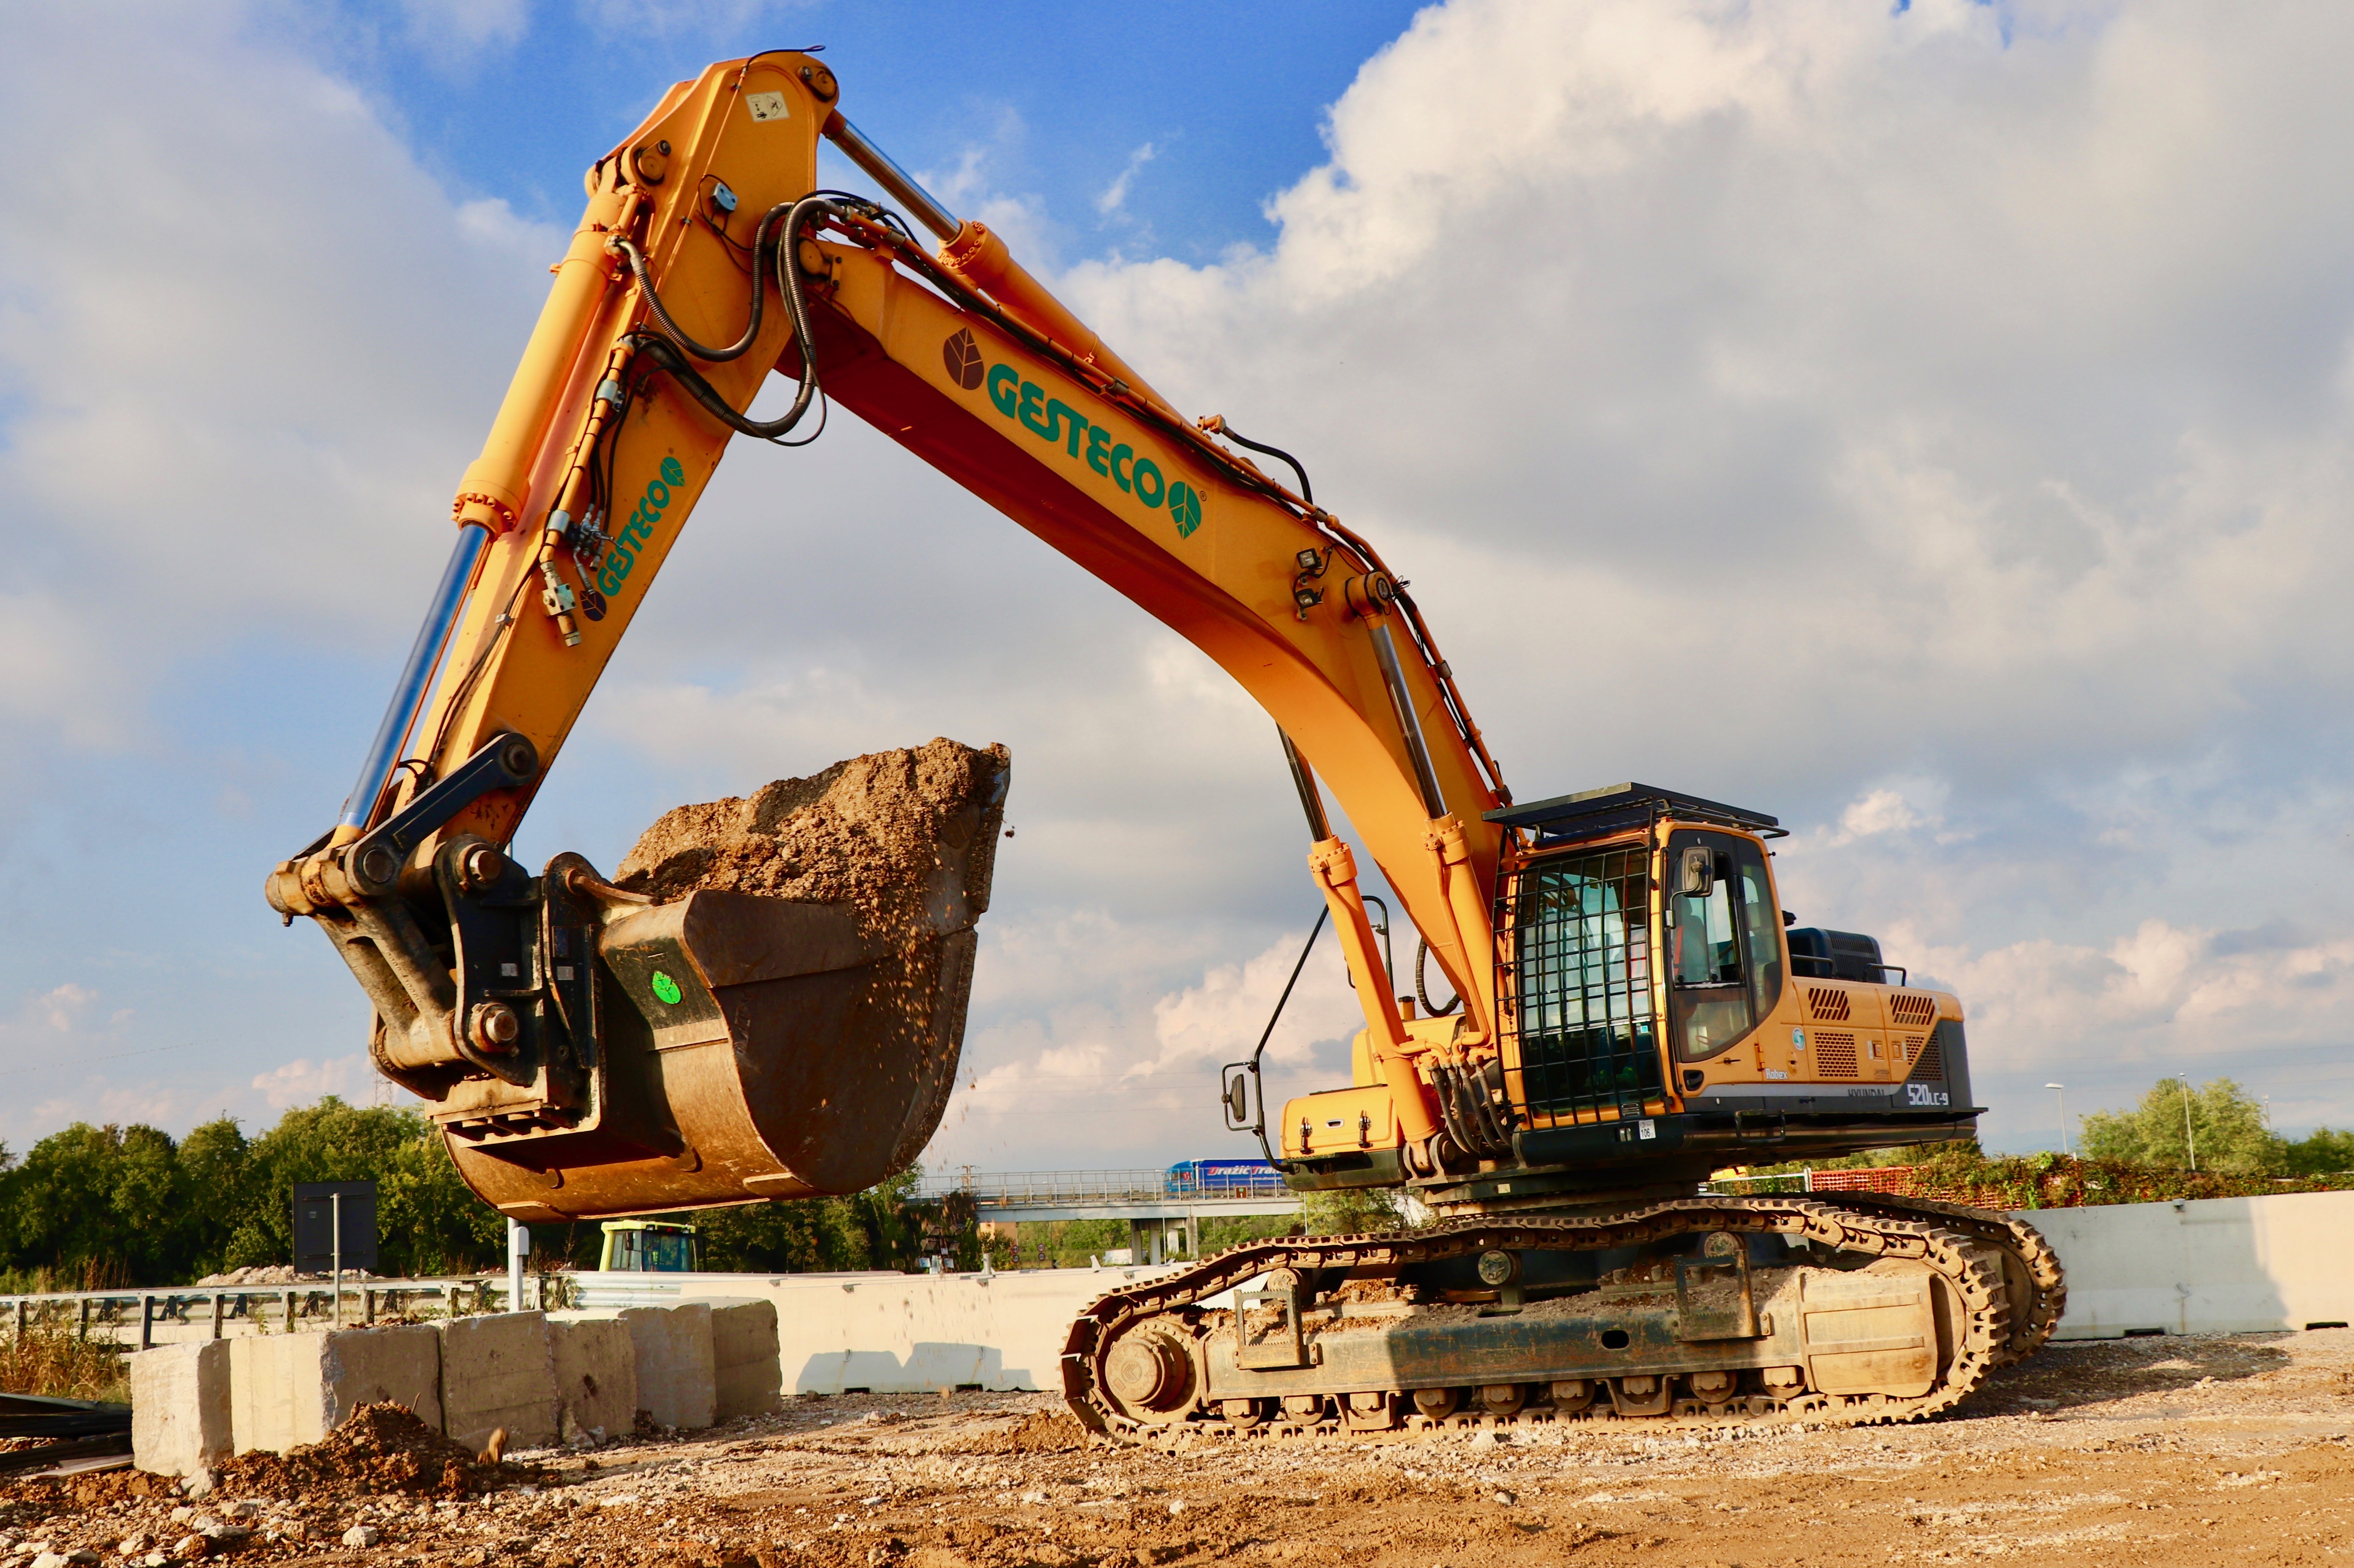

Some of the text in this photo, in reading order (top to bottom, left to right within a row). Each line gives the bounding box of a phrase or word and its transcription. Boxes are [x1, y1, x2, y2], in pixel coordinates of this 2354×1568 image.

[987, 363, 1165, 509] GESTECO
[598, 480, 670, 596] GESTECO
[1765, 1068, 1788, 1080] Robex
[1641, 1128, 1651, 1138] 106
